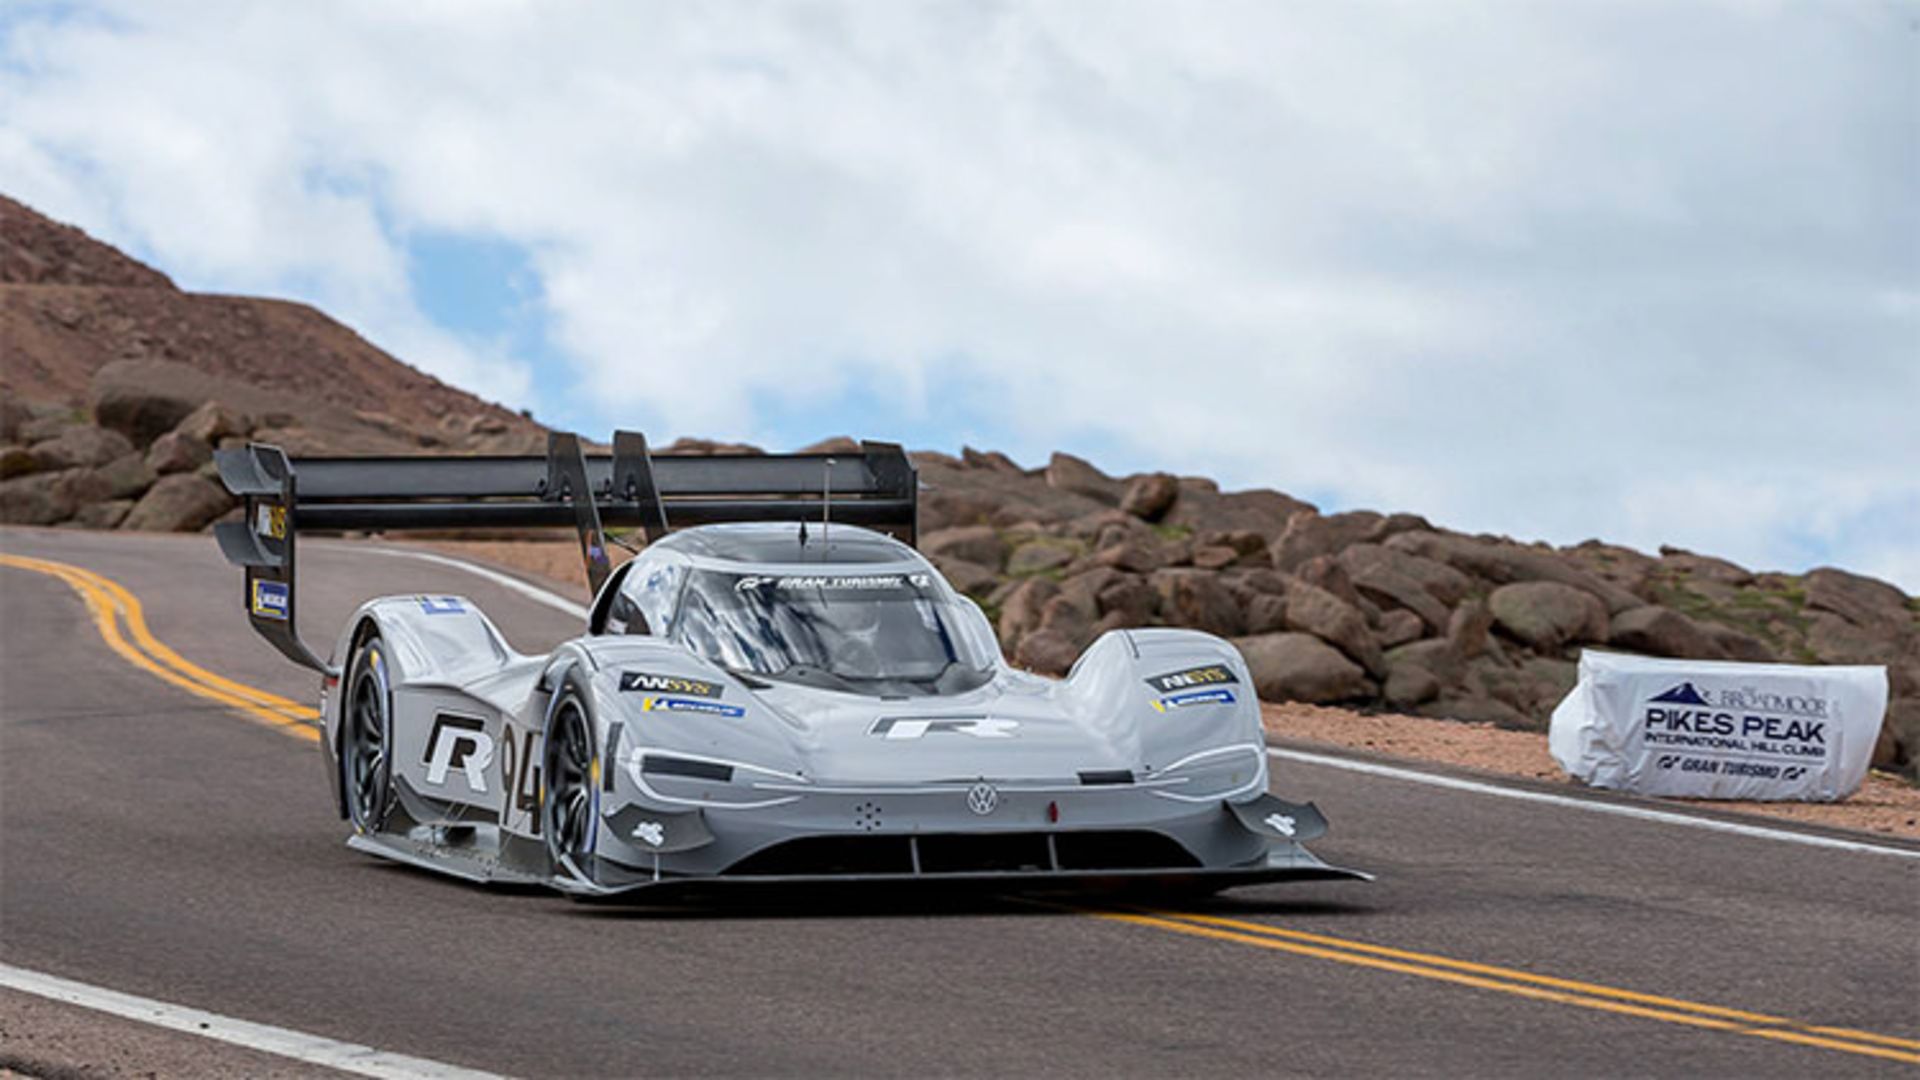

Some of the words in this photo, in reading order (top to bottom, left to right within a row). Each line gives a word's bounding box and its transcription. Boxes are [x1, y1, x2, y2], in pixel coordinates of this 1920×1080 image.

[631, 675, 712, 695] ANSYS
[1645, 708, 1735, 736] PIKES
[1742, 716, 1826, 744] PEAK
[422, 711, 495, 793] R
[1644, 731, 1748, 750] INTERNATIONAL
[1751, 740, 1779, 754] HILL
[1782, 745, 1827, 757] CLIMB
[1681, 756, 1718, 773] GRAN
[1721, 761, 1780, 779] TURISMO
